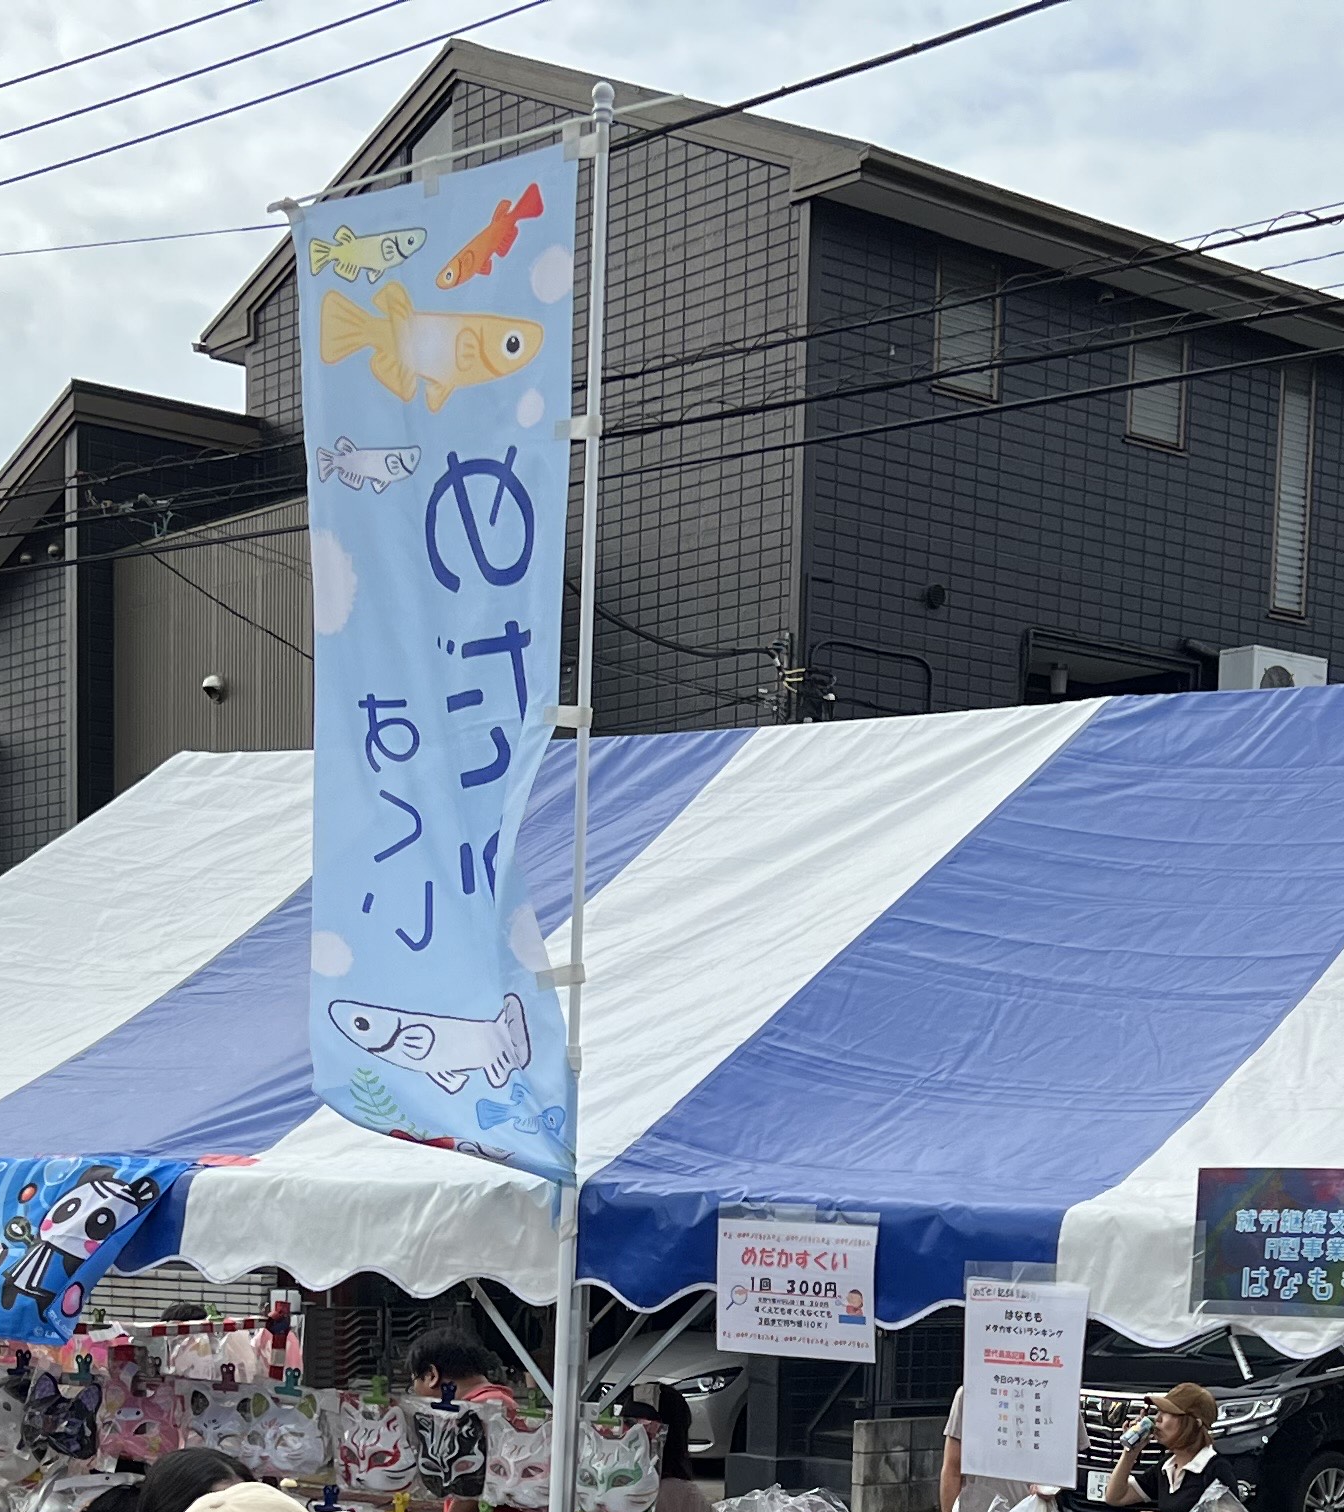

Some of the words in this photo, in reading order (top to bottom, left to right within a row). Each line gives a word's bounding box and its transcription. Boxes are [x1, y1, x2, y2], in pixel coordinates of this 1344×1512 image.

[741, 1246, 849, 1271] めだかすくい
[750, 1277, 772, 1292] 1回
[787, 1279, 837, 1298] 300円
[1004, 1309, 1043, 1323] はなもも
[1029, 1346, 1050, 1362] 62
